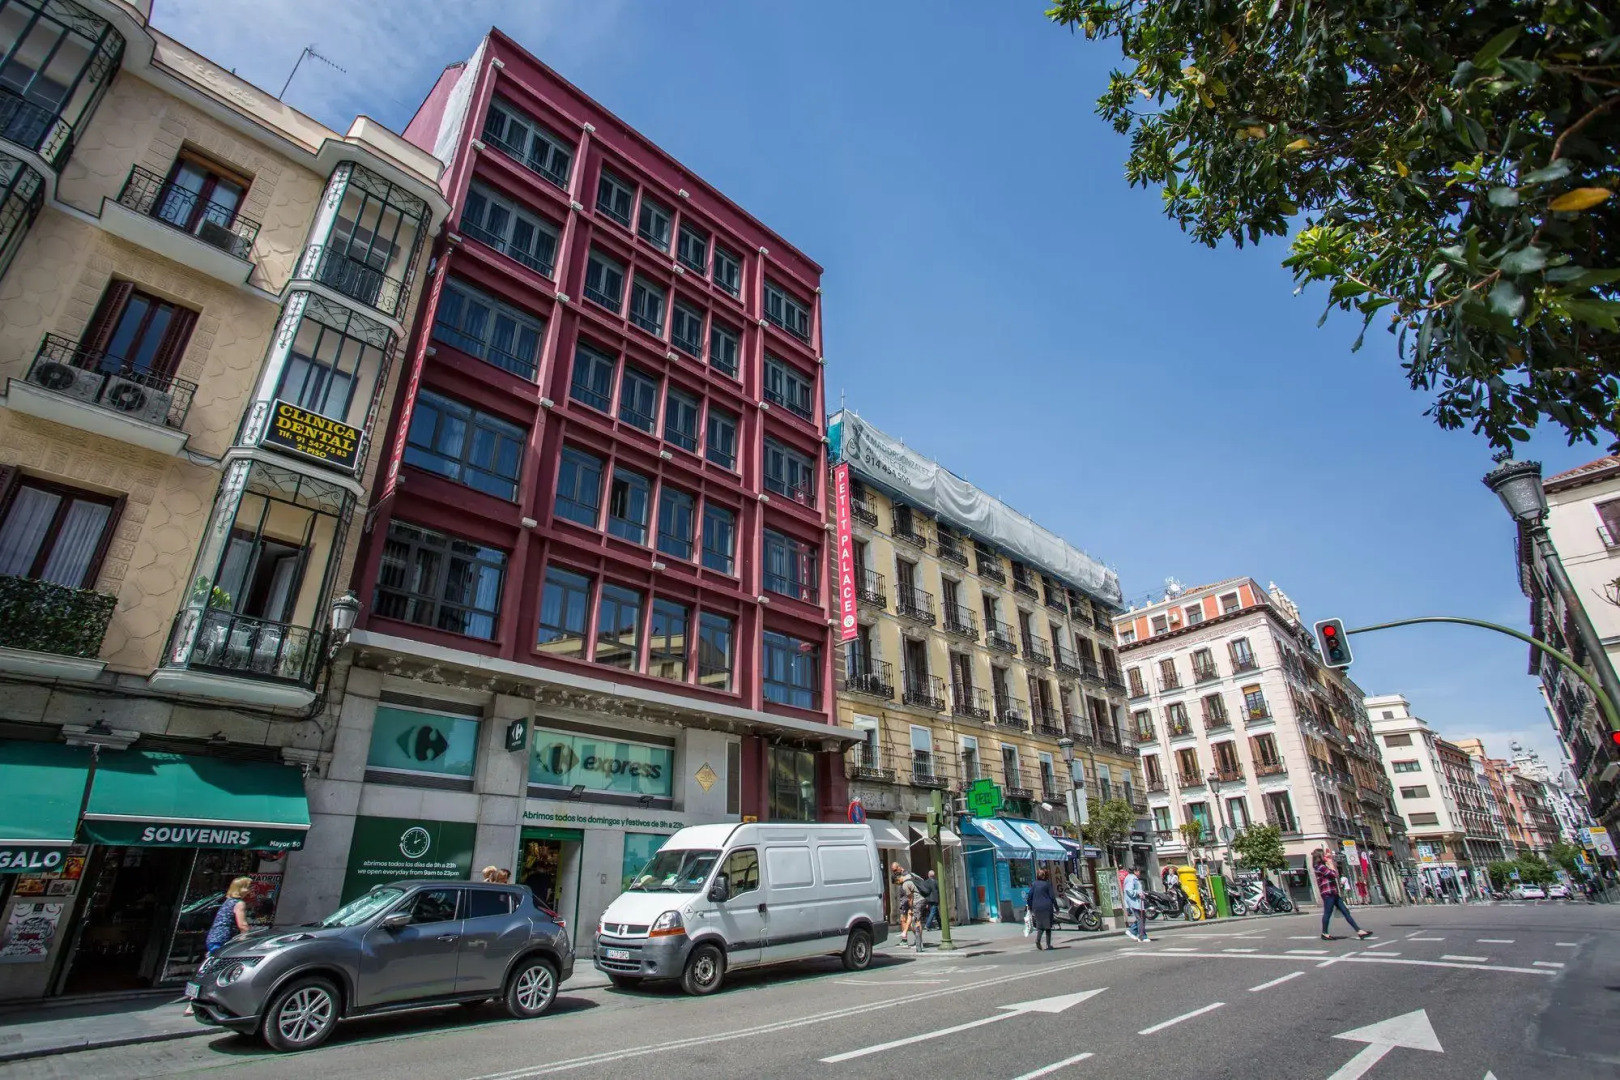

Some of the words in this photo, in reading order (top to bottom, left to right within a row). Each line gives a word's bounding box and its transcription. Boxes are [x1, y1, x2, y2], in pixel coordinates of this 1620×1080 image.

[424, 266, 444, 344] PETIT
[395, 350, 424, 455] PALACE
[280, 405, 356, 440] CLINICA
[276, 416, 353, 451] DENTAL
[296, 435, 305, 443] 91
[307, 447, 327, 458] PISO
[865, 454, 880, 469] 914
[838, 471, 848, 530] PETIT
[841, 535, 852, 612] PALACE
[583, 755, 661, 779] express
[522, 811, 554, 820] Abrimos
[555, 813, 575, 822] todos
[577, 814, 587, 823] los
[588, 815, 620, 826] domingos
[625, 818, 650, 826] festivos
[142, 826, 251, 845] SOUVENIRS
[269, 840, 290, 848] Mayor
[0, 851, 61, 868] GALO
[250, 874, 282, 882] MADRID
